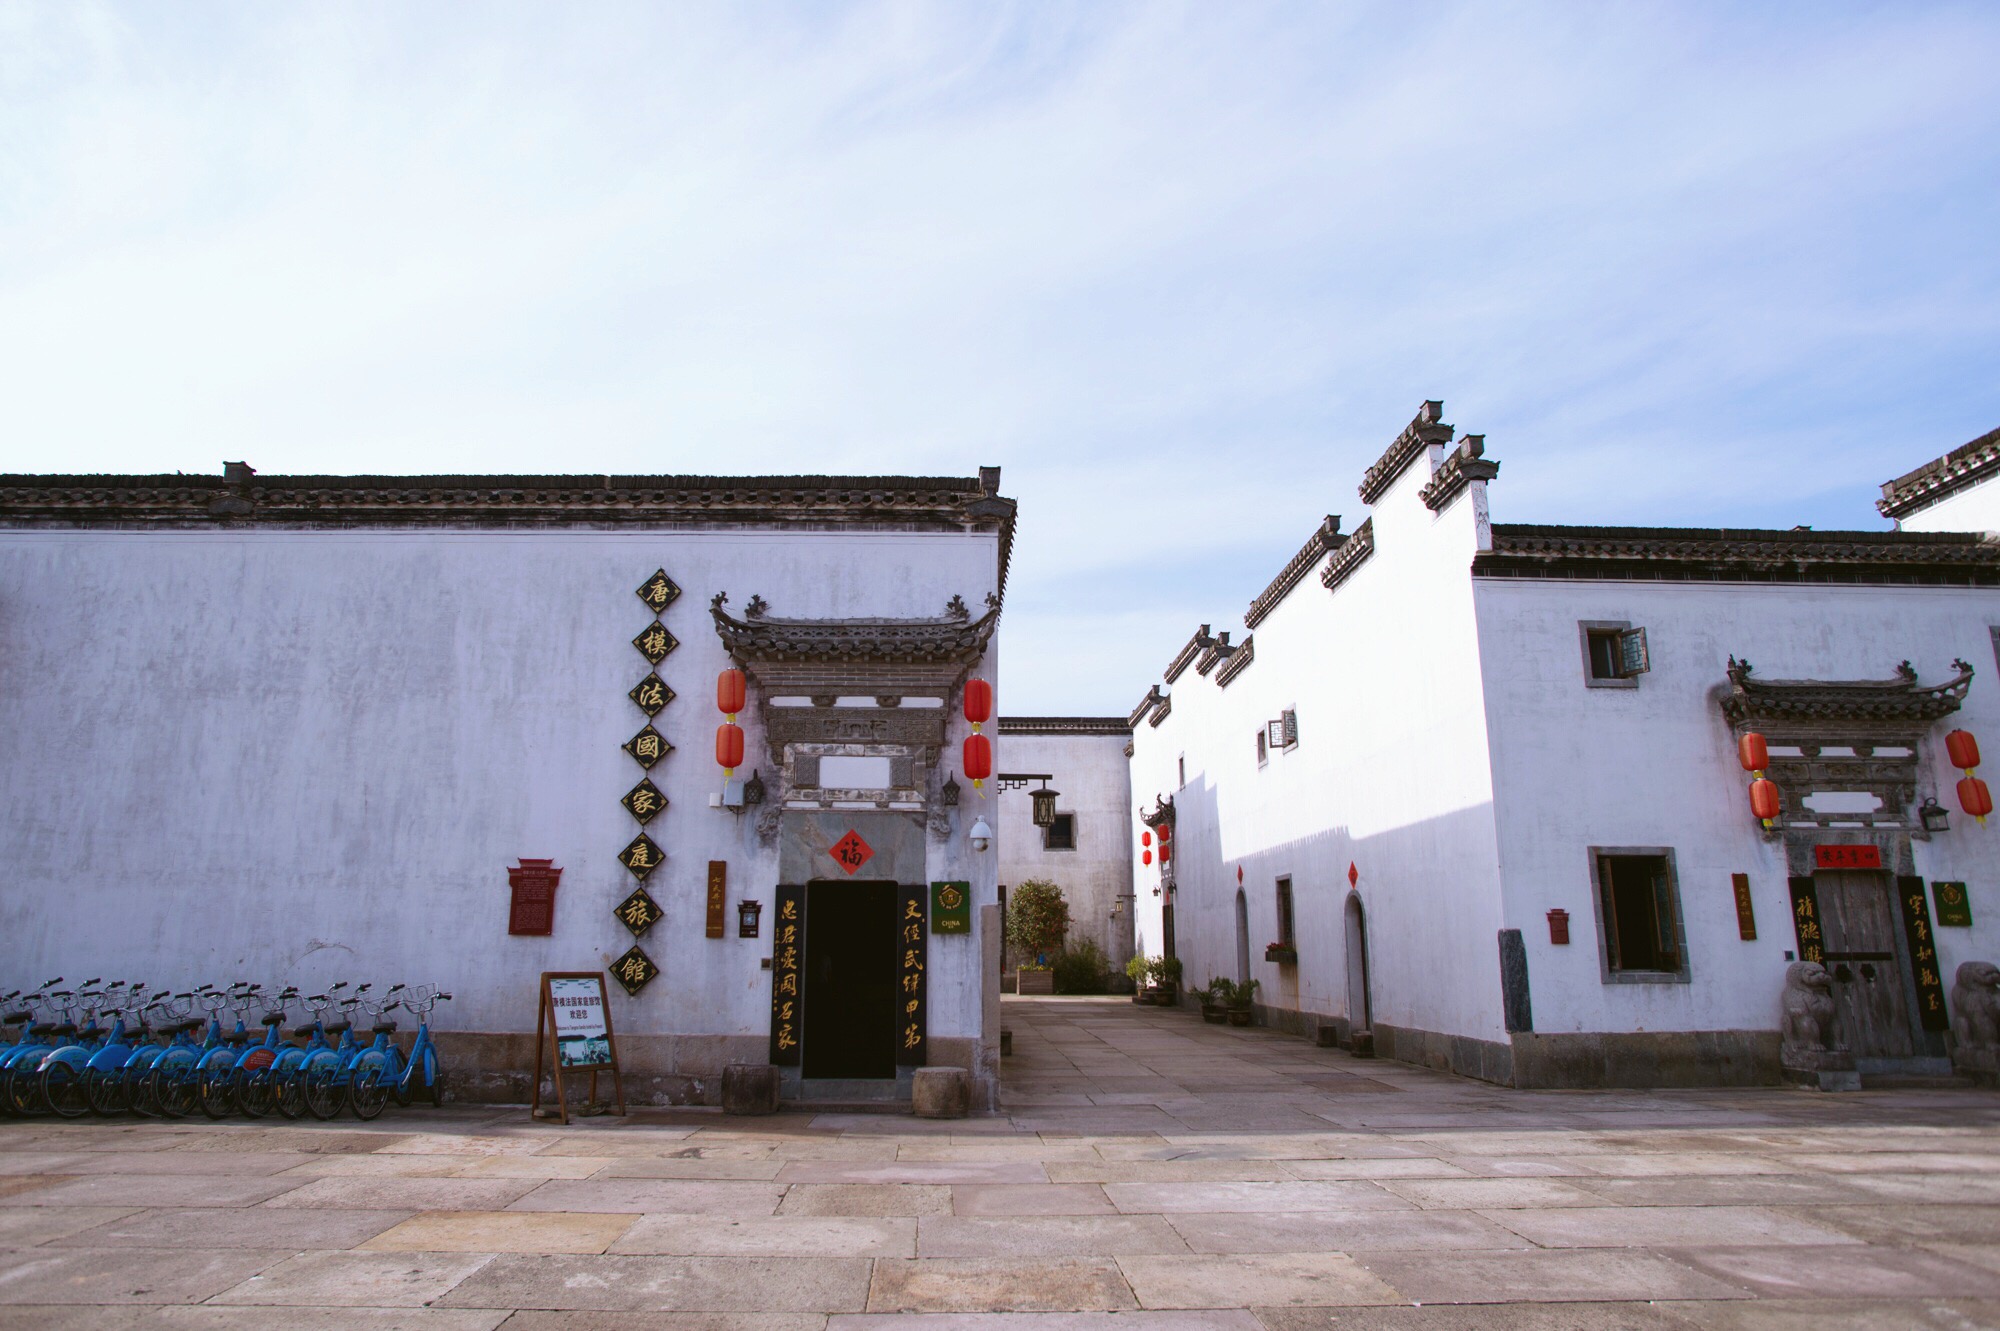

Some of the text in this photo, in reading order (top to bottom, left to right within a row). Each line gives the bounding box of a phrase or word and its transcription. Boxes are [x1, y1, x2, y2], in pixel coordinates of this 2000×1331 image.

[620, 579, 671, 984] 唐模法國家庭旅館
[839, 838, 864, 866] 福
[569, 1009, 588, 1020] 欢迎您
